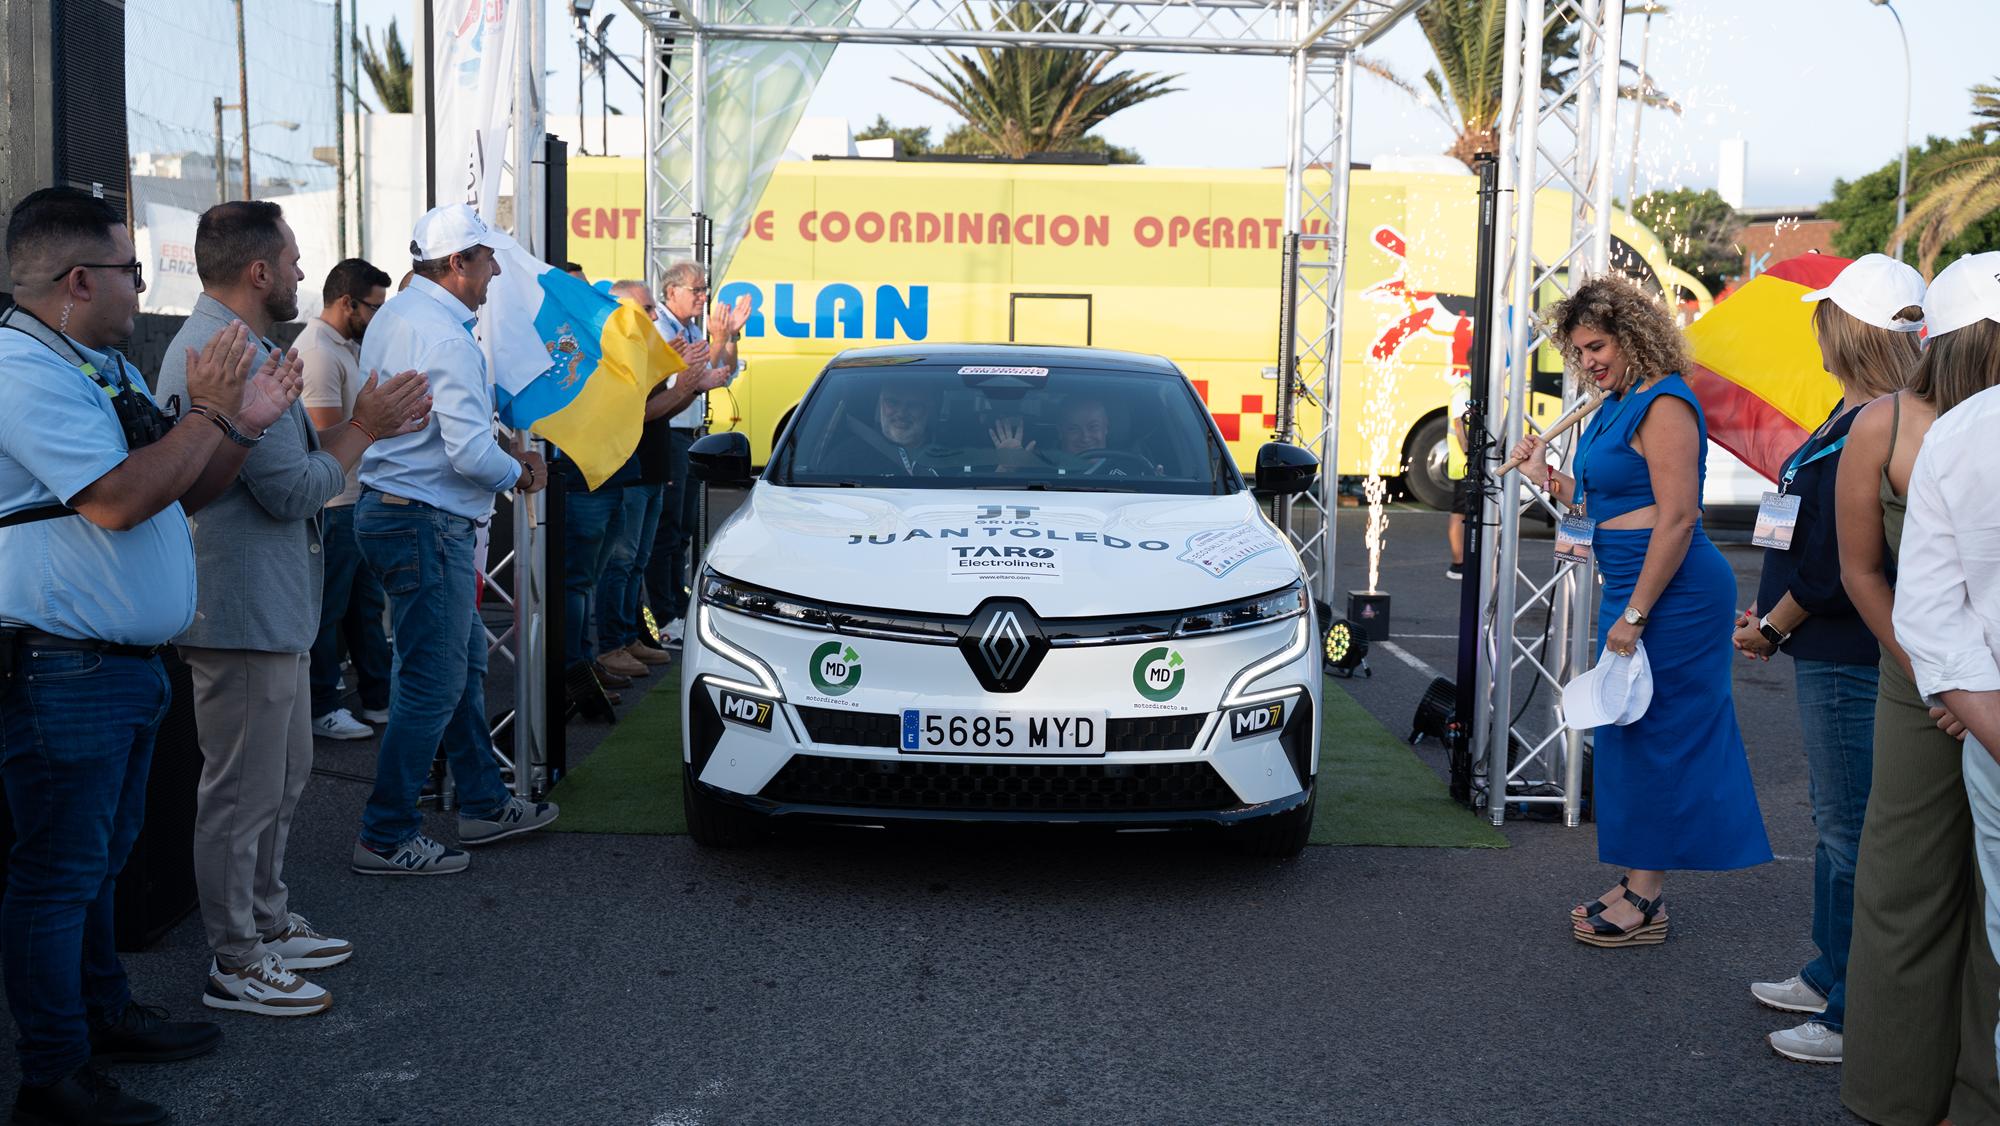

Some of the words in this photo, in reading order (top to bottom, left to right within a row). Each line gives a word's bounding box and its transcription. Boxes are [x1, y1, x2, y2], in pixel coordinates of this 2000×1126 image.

[571, 207, 642, 240] ENT
[799, 210, 1110, 247] COORDINACION
[1133, 215, 1330, 250] OPERATV
[718, 280, 929, 342] RLAN
[976, 504, 1041, 520] JT
[847, 527, 969, 546] JUAN
[982, 527, 1170, 551] TOLEDO
[951, 546, 1055, 559] TARO
[959, 559, 1055, 568] Electrolinera
[825, 661, 846, 677] MD
[1150, 668, 1171, 682] MD
[724, 695, 771, 724] MD7
[806, 695, 859, 708] motordirecto.es
[1133, 703, 1188, 711] motordirecto.es
[1235, 704, 1281, 734] MD7
[908, 733, 914, 743] E
[926, 715, 1014, 747] 5685
[1029, 717, 1094, 748] MYD
